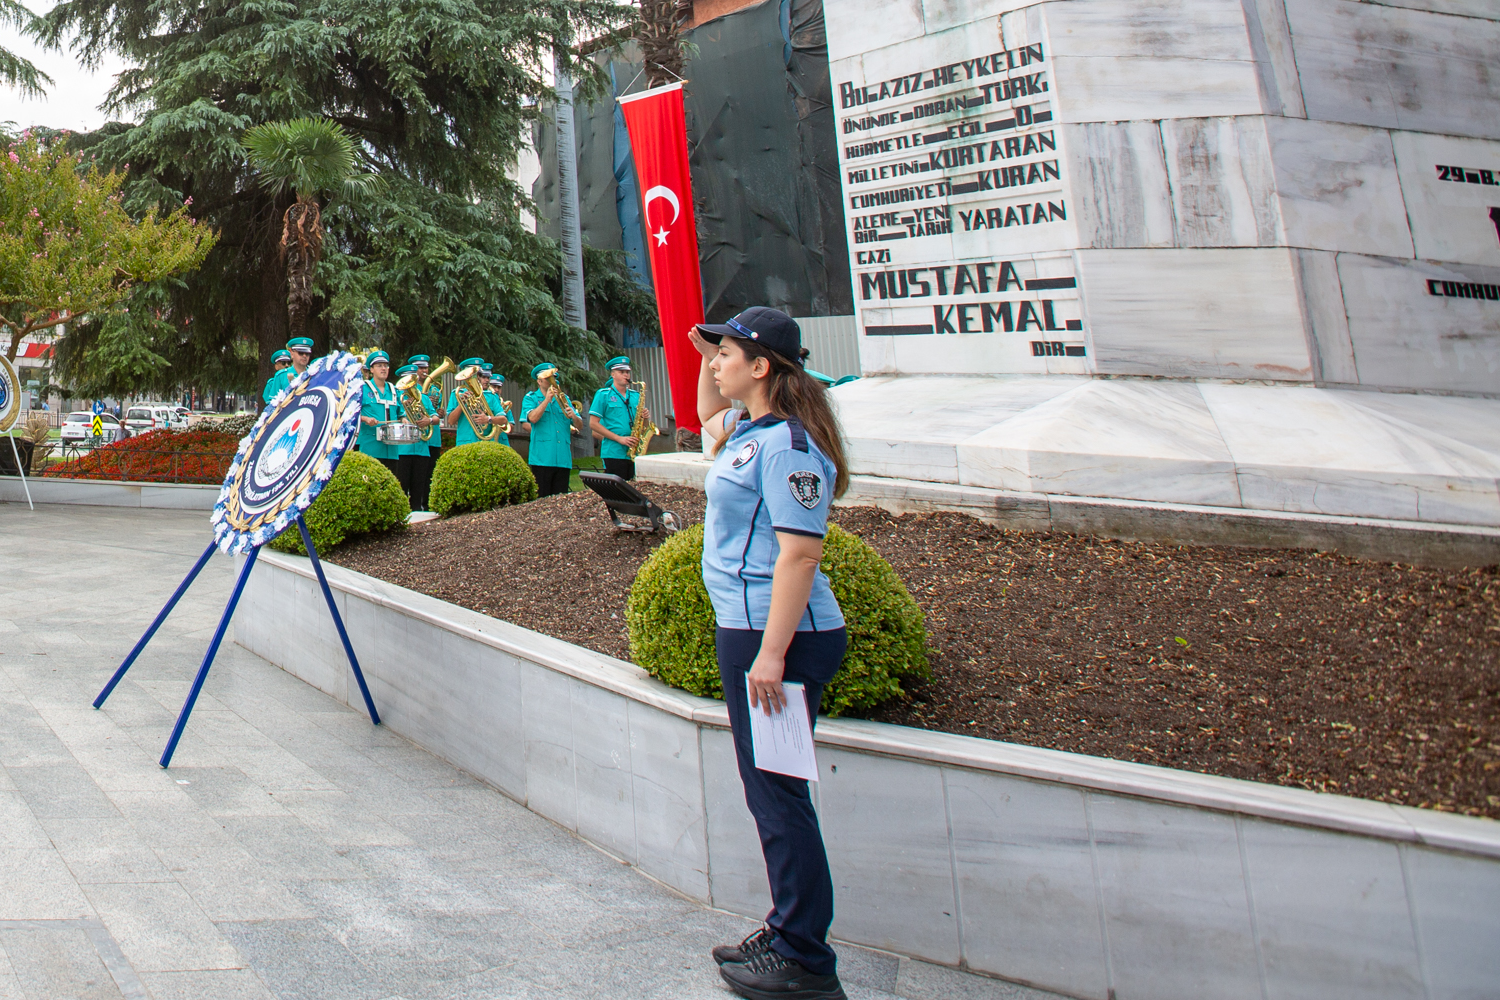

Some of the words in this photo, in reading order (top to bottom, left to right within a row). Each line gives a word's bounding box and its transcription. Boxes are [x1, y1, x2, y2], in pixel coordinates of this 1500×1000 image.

[879, 72, 924, 100] AZİZ
[933, 42, 1045, 88] HEYKELİN
[843, 111, 901, 135] ÖNÜNDE
[913, 95, 968, 120] DURAN
[845, 132, 923, 160] HÜRMETLE
[1015, 104, 1033, 128] O
[848, 160, 919, 185] MİLLETİNİ
[928, 130, 1056, 171] KURTARAN
[1435, 165, 1466, 182] 29
[850, 177, 952, 210] CUMHURİYETİ
[977, 158, 1061, 192] KURAN
[854, 229, 879, 244] BİR
[906, 219, 953, 239] TARİH
[958, 199, 1068, 232] YARATAN
[856, 248, 892, 266] GAZİ
[860, 260, 1024, 301] MUSTAFA
[1426, 279, 1500, 301] CUMHU
[933, 298, 1067, 335] KEMAL
[1031, 340, 1066, 357] DİR
[298, 394, 322, 408] BURSA
